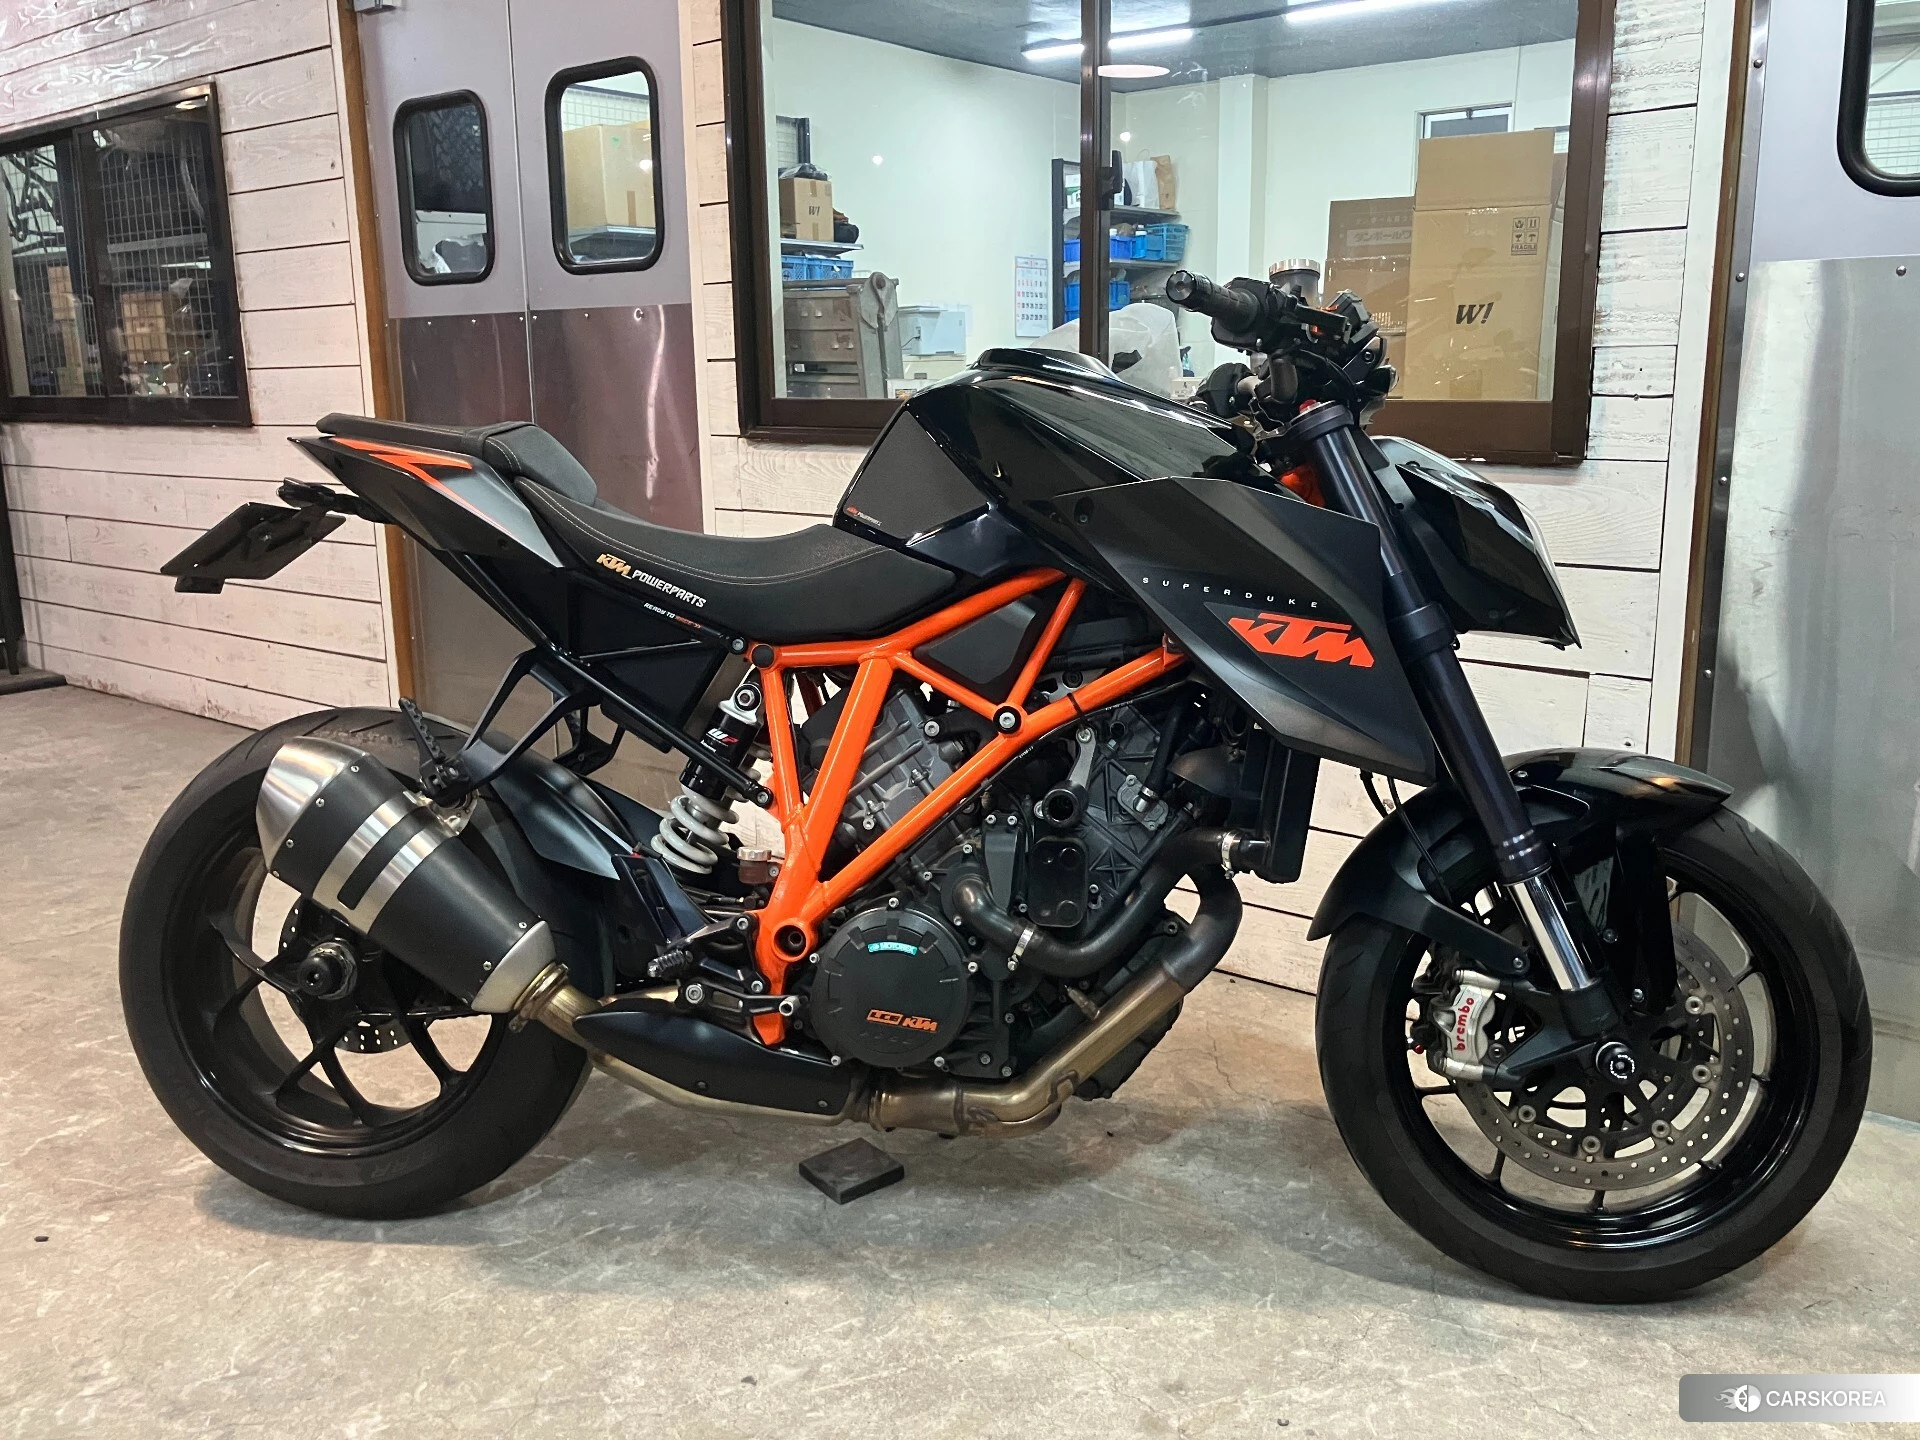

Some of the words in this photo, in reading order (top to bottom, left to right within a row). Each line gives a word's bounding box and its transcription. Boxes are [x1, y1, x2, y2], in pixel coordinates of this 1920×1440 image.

[1455, 301, 1495, 325] W!
[596, 553, 632, 576] KTM
[632, 569, 707, 608] POWERPARTS
[643, 602, 667, 615] READY
[666, 611, 676, 619] TO
[1228, 612, 1375, 668] KTM
[902, 1015, 938, 1032] KTM
[1453, 997, 1475, 1052] brembo
